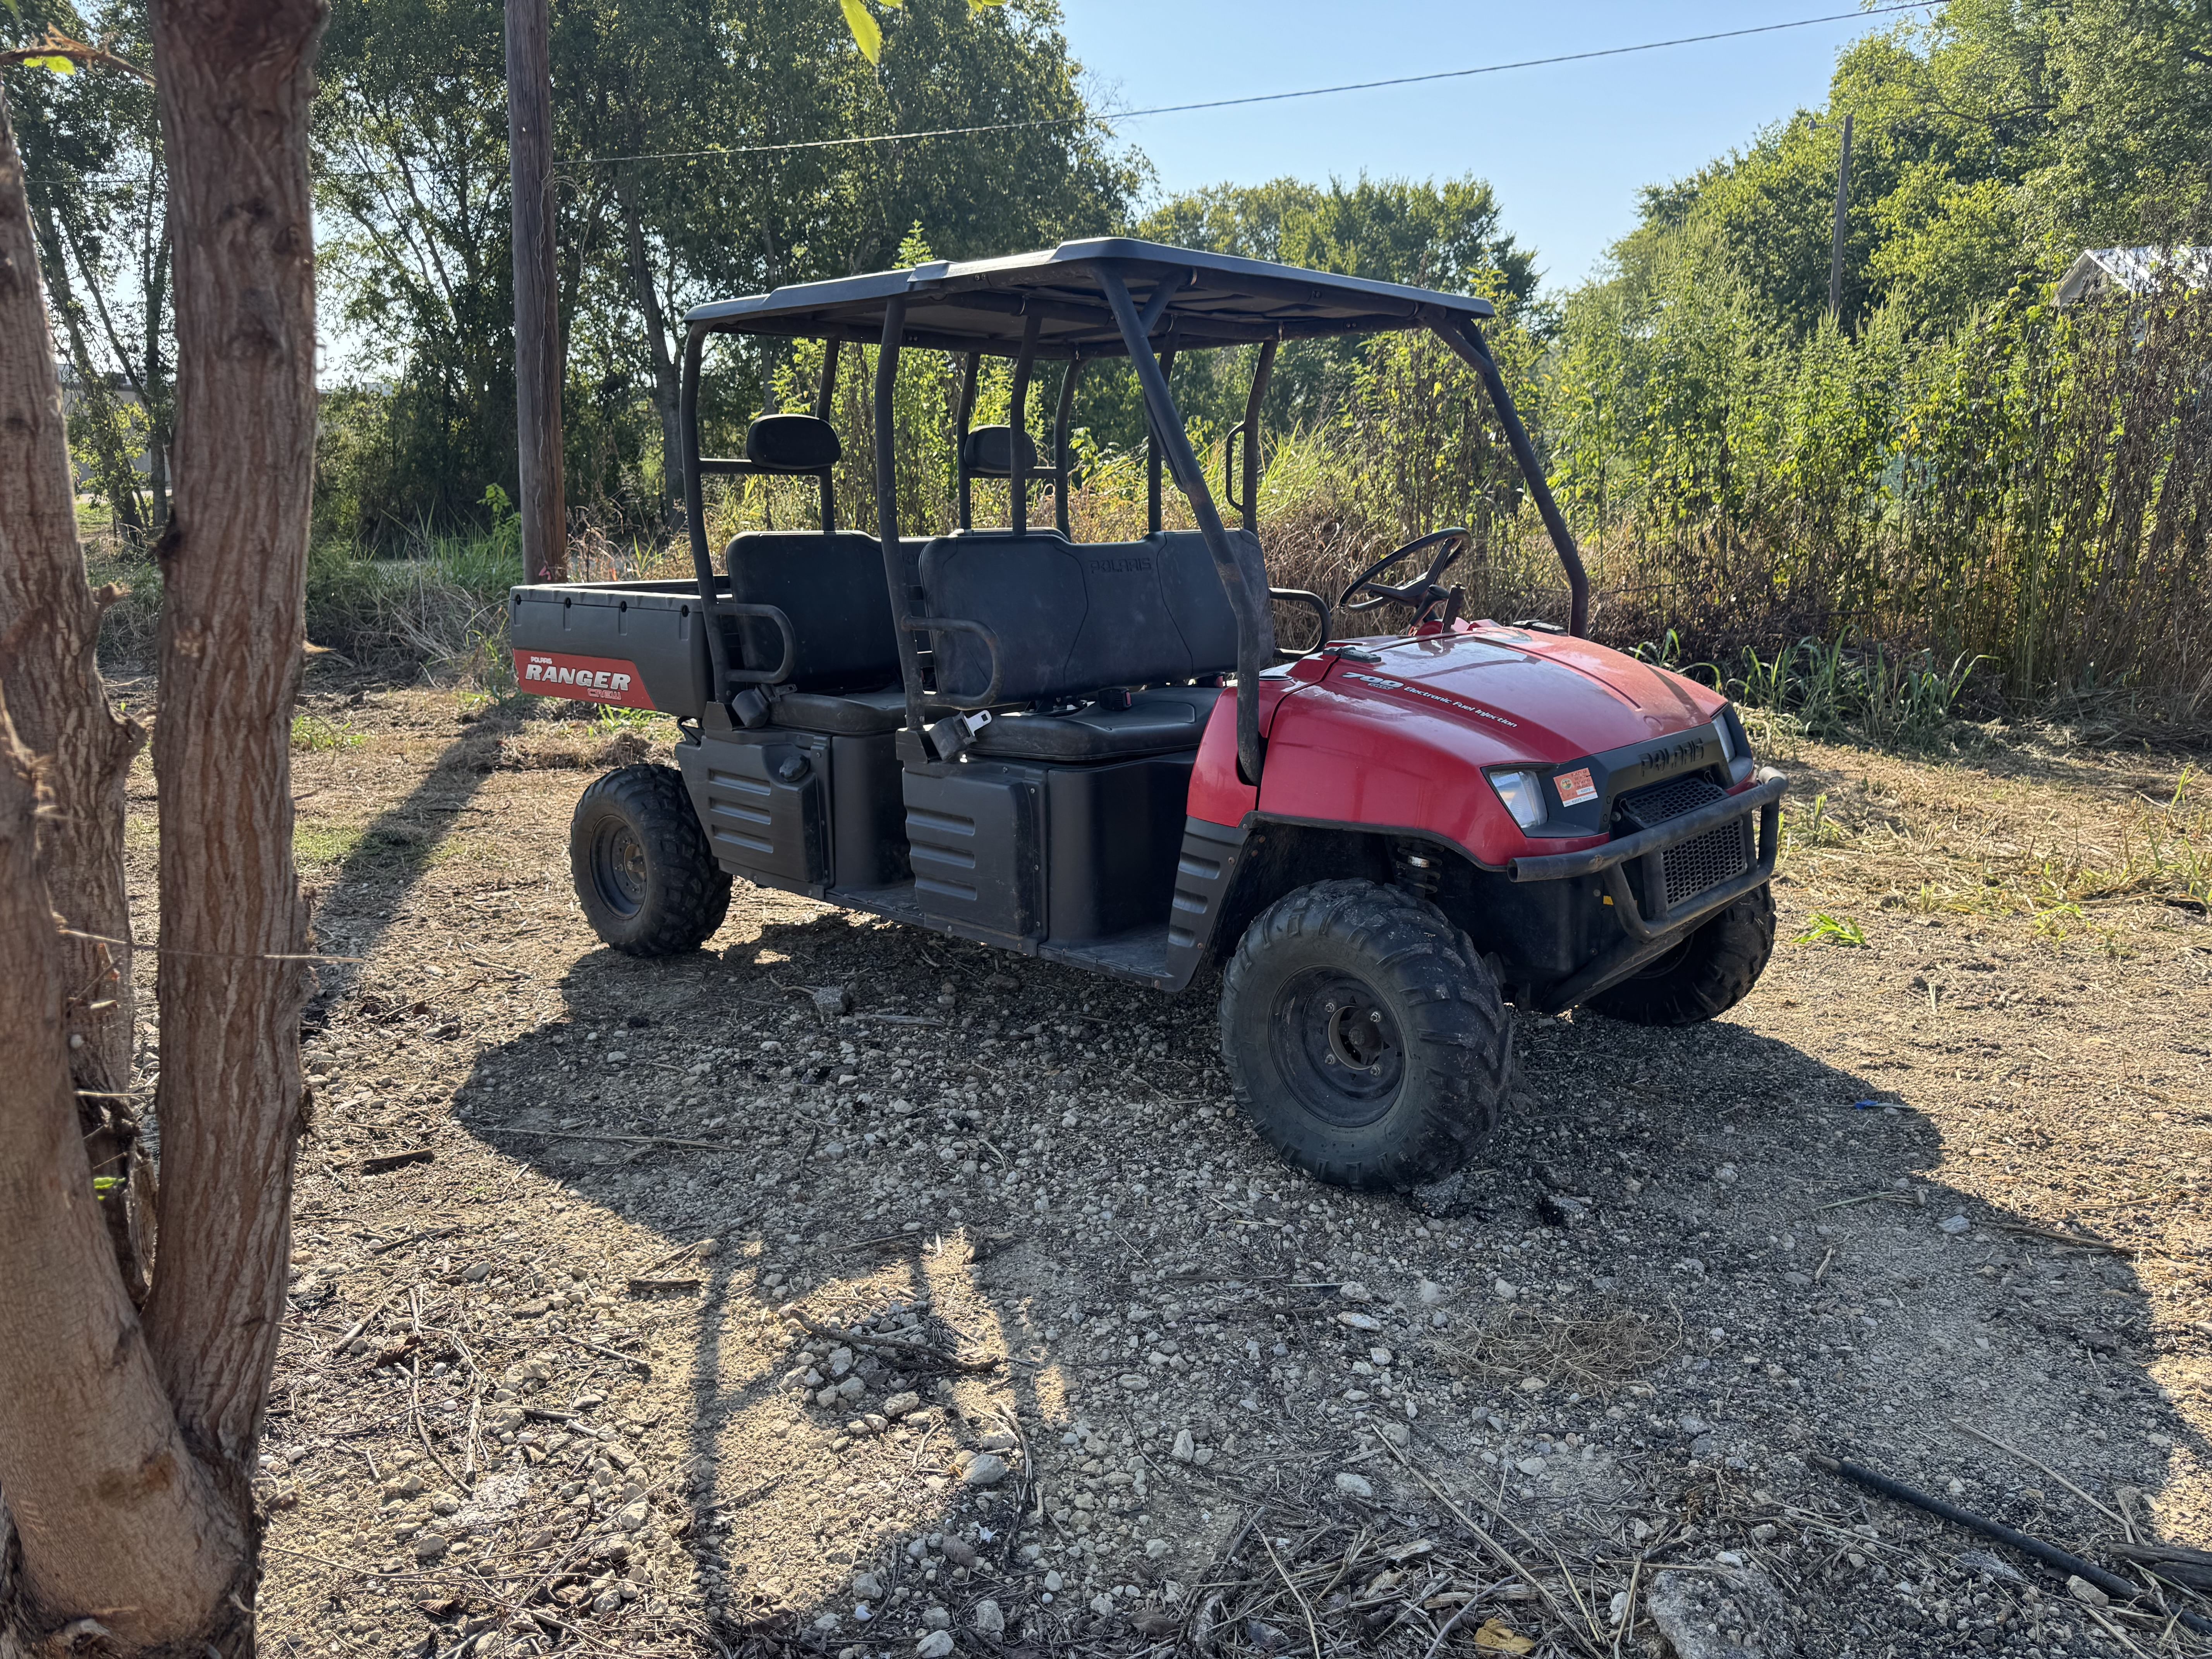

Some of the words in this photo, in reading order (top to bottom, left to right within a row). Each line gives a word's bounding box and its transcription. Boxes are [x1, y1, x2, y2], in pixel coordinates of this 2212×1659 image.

[1089, 558, 1151, 574] POLARIS
[531, 656, 553, 665] POLARIS
[525, 663, 631, 691] RANGER
[587, 688, 622, 701] CREW
[1342, 672, 1404, 688] 700
[1404, 686, 1452, 704] Electronic
[1453, 701, 1476, 711] Fuel
[1475, 709, 1518, 728] Injection
[1638, 737, 1704, 777] POLARIS
